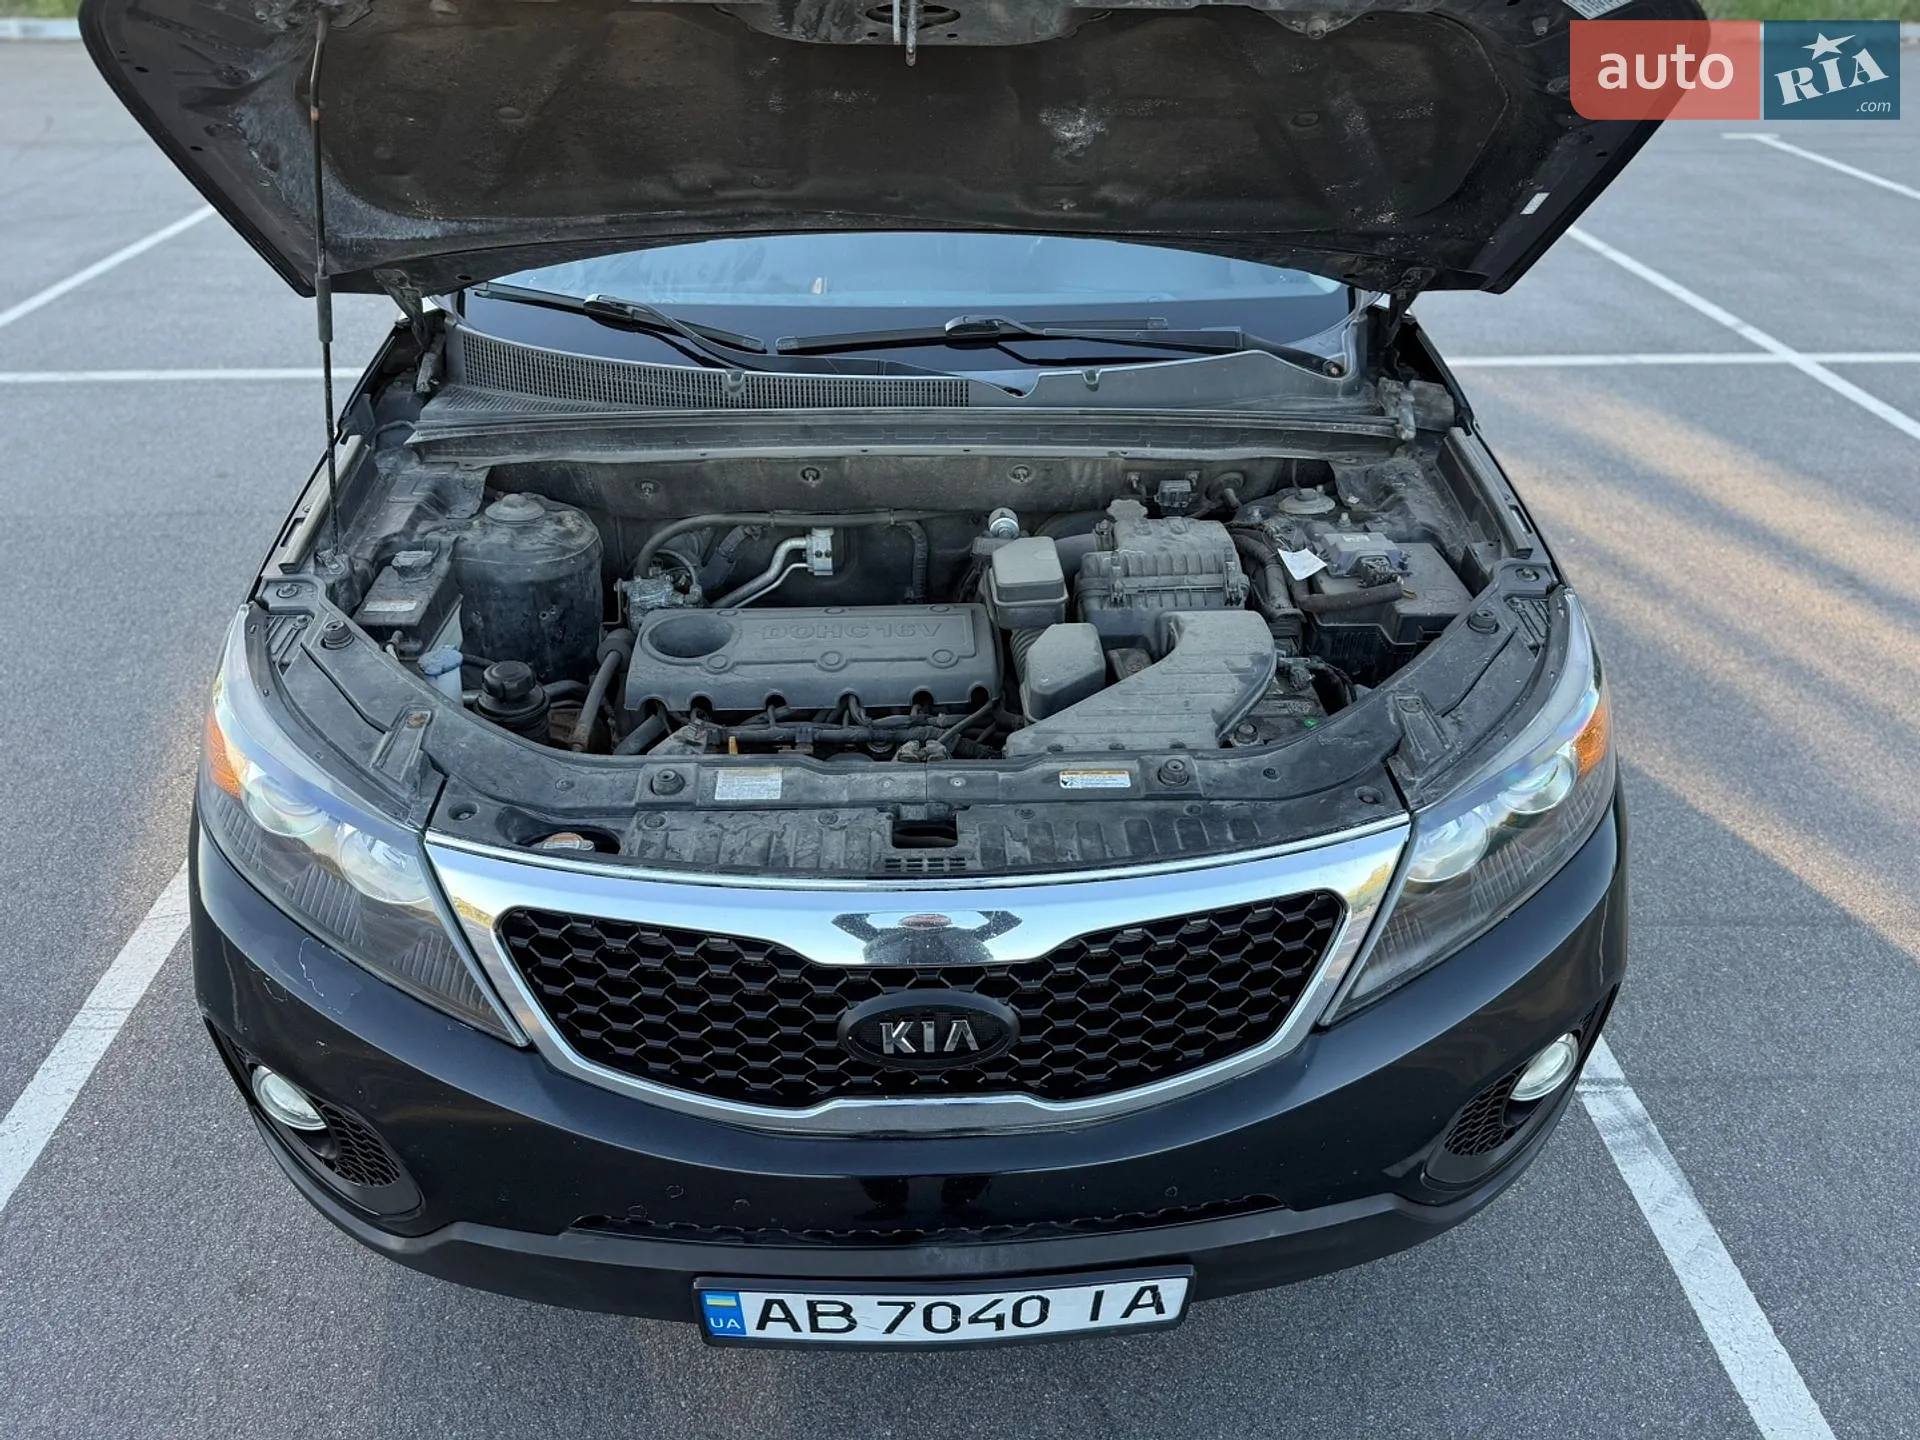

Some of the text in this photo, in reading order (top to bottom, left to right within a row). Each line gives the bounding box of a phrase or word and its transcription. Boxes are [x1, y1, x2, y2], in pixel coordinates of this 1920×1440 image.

[879, 1019, 980, 1055] KIA
[709, 1316, 741, 1330] UA
[755, 1298, 858, 1334] AB
[876, 1294, 1051, 1335] 7040
